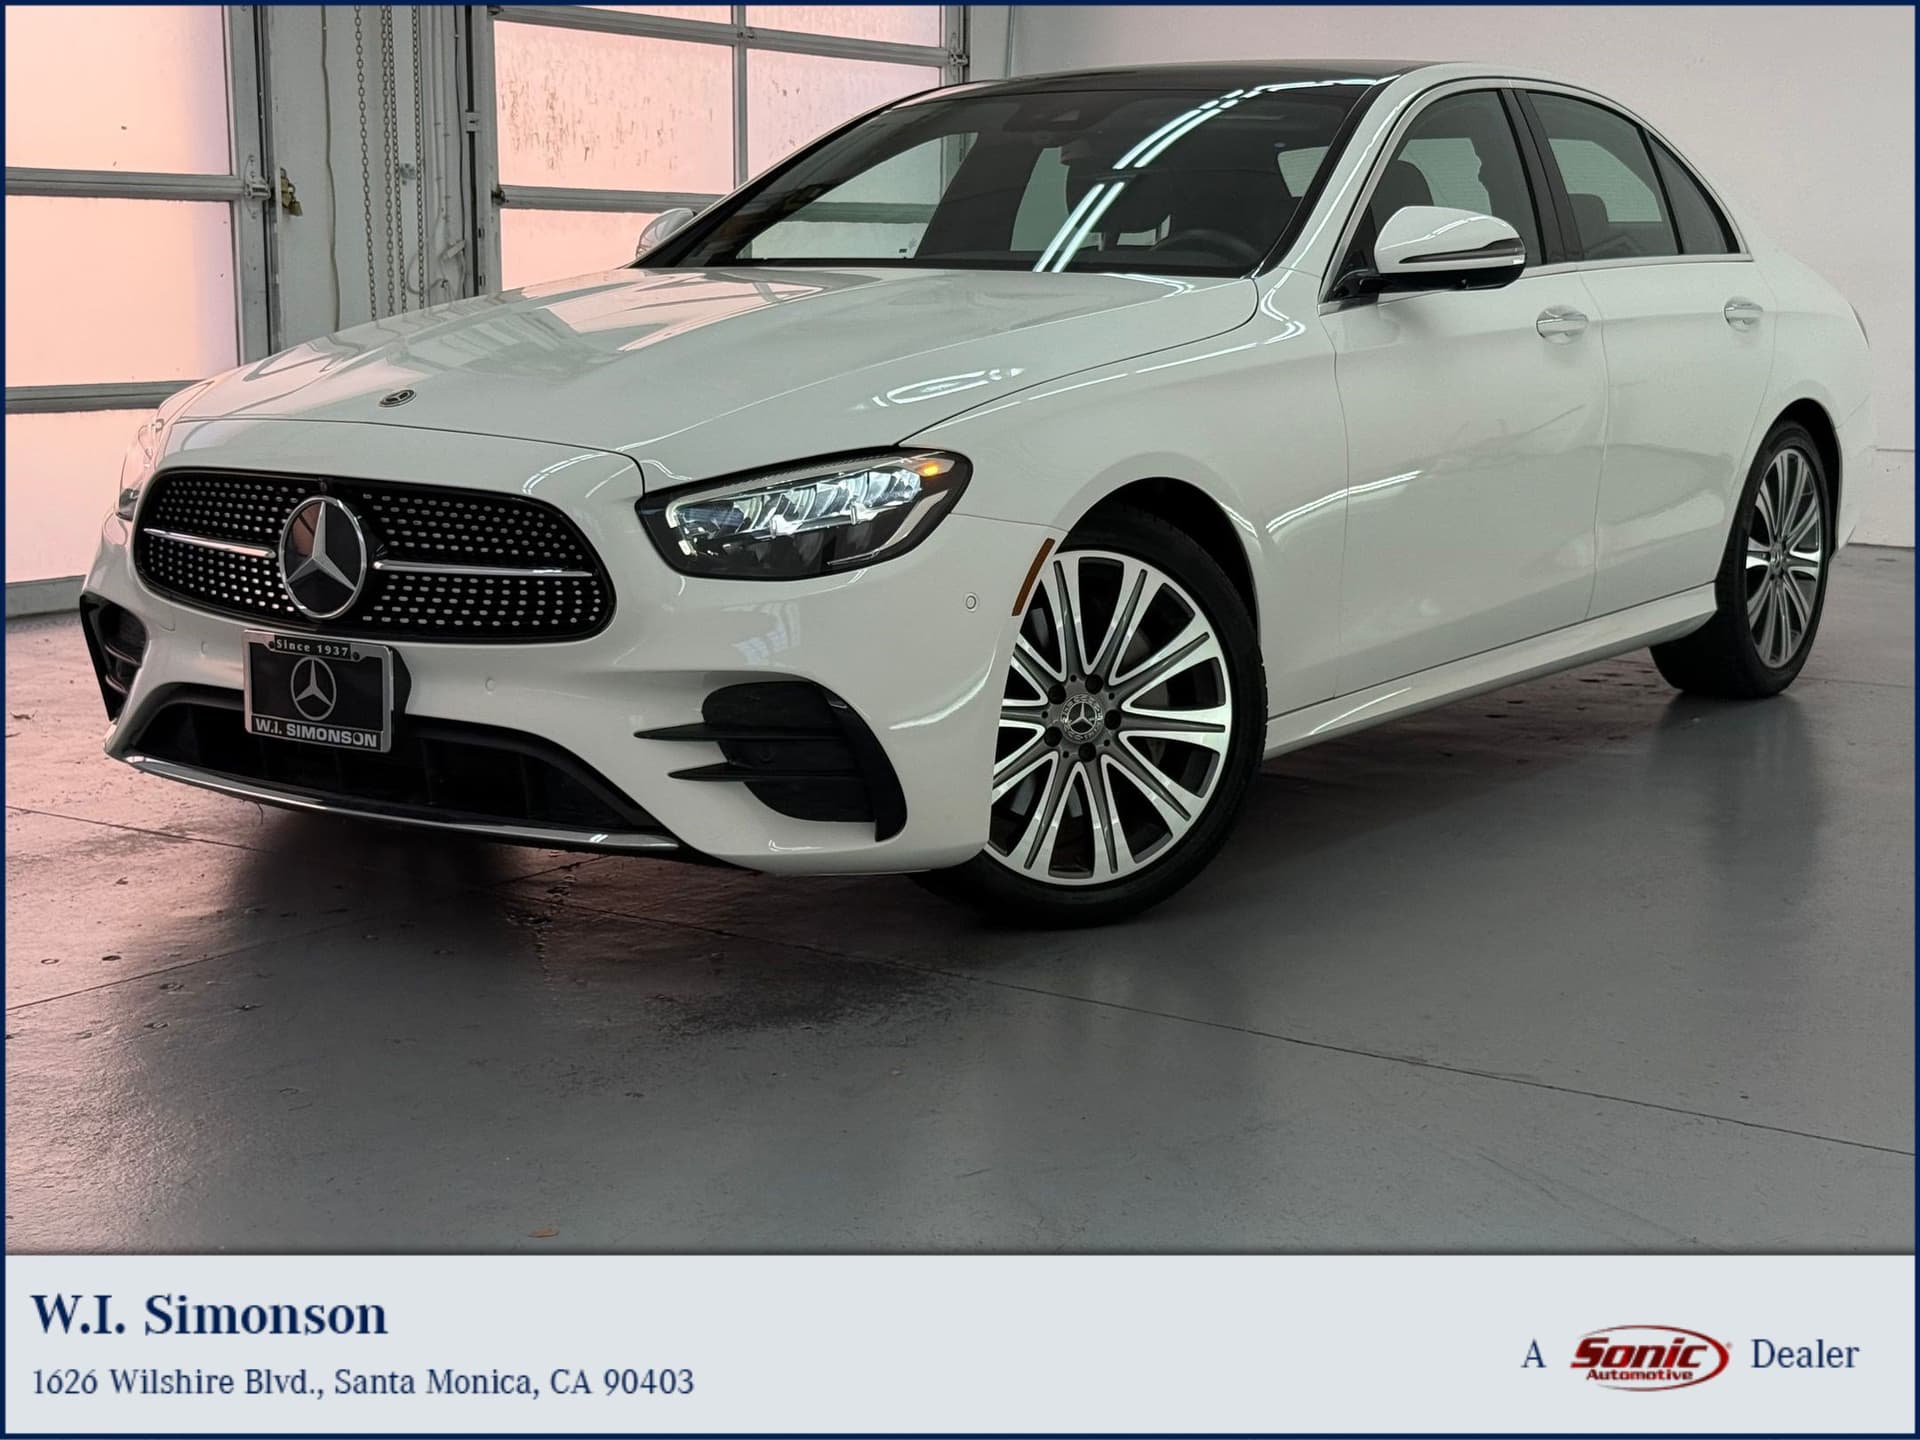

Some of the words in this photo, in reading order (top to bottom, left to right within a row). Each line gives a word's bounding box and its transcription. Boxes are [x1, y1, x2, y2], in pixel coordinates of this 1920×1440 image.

[276, 639, 311, 653] Since
[317, 644, 349, 657] 1937
[255, 717, 283, 735] W.I.
[286, 723, 377, 748] SIMONSON
